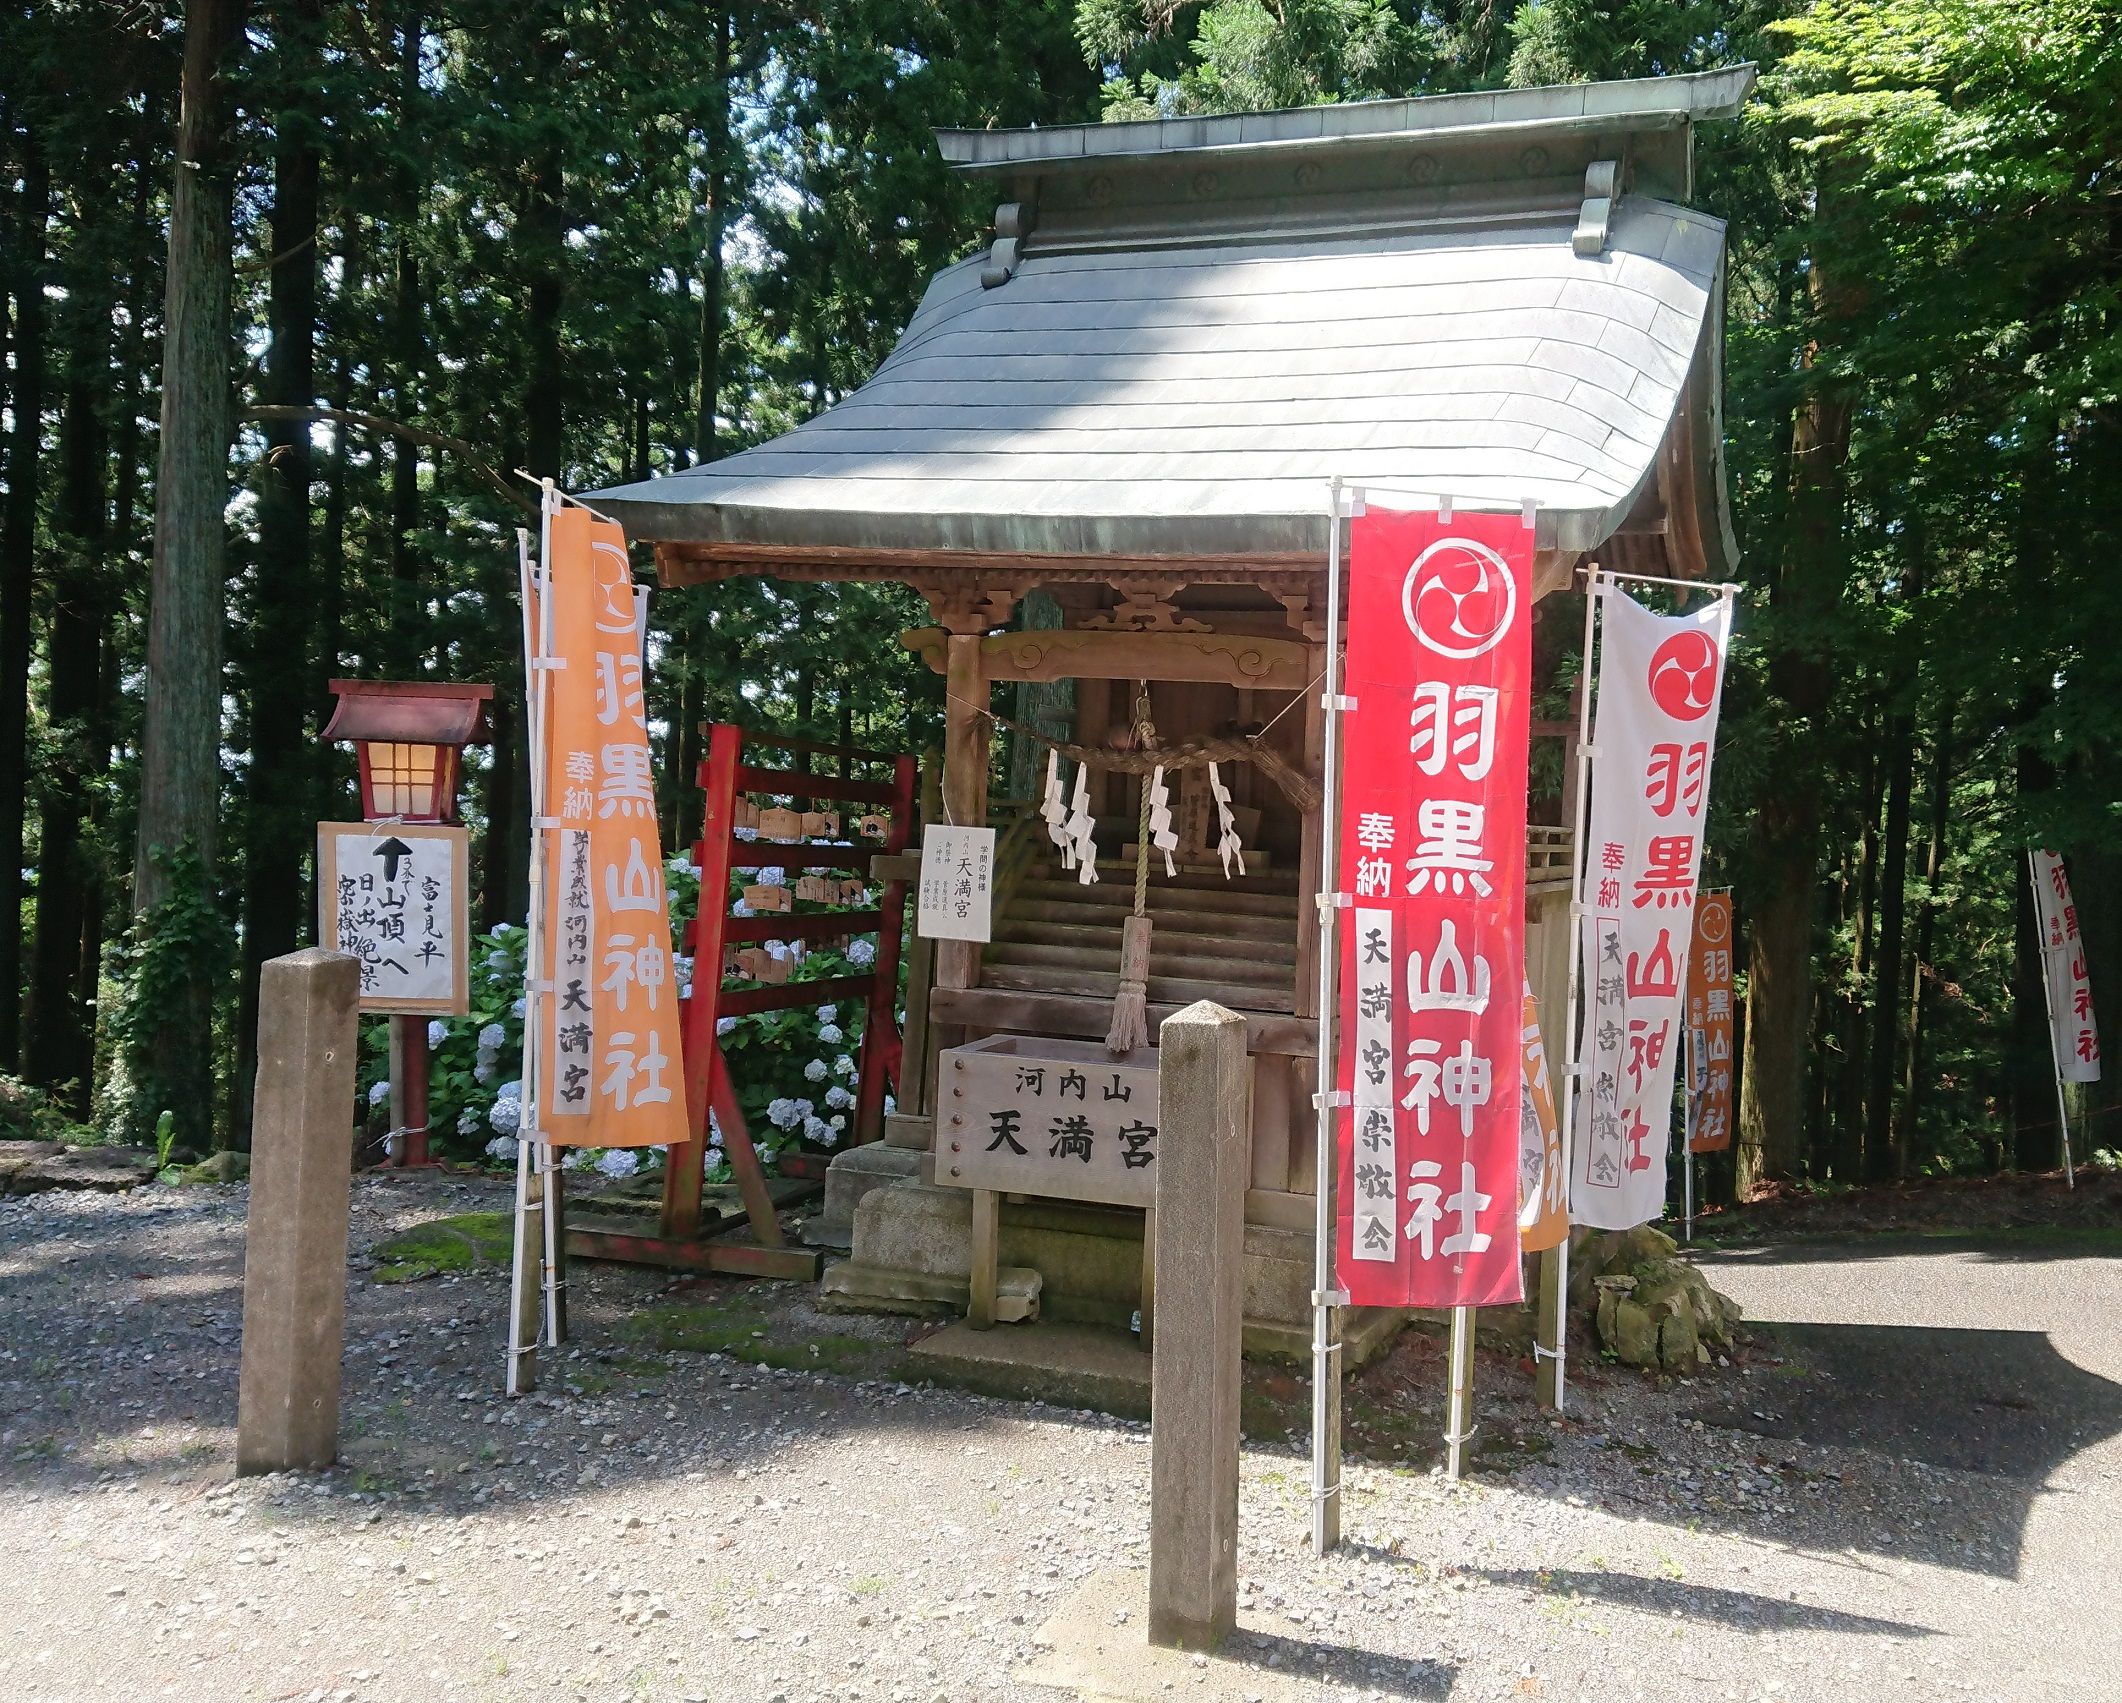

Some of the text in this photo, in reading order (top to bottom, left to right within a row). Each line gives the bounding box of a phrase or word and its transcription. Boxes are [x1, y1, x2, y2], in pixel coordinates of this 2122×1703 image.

[563, 751, 594, 821] 奉納
[595, 651, 673, 1112] 羽黒山神社
[978, 846, 988, 892] 学問の神様
[1356, 812, 1396, 898] 奉納
[1598, 841, 1625, 909] 奉納
[376, 887, 409, 975] 山頂へ
[414, 876, 445, 969] 富士見平
[1621, 741, 1708, 1174] 羽黒山神社
[1400, 681, 1499, 1261] 羽黒山神社
[1015, 1066, 1132, 1103] 河内山
[1591, 931, 1625, 1183] 天満宮崇敬会
[1700, 950, 1730, 1138] 羽黒山神社
[1355, 928, 1396, 1252] 天満宮崇敬会
[985, 1110, 1158, 1169] 天満宮
